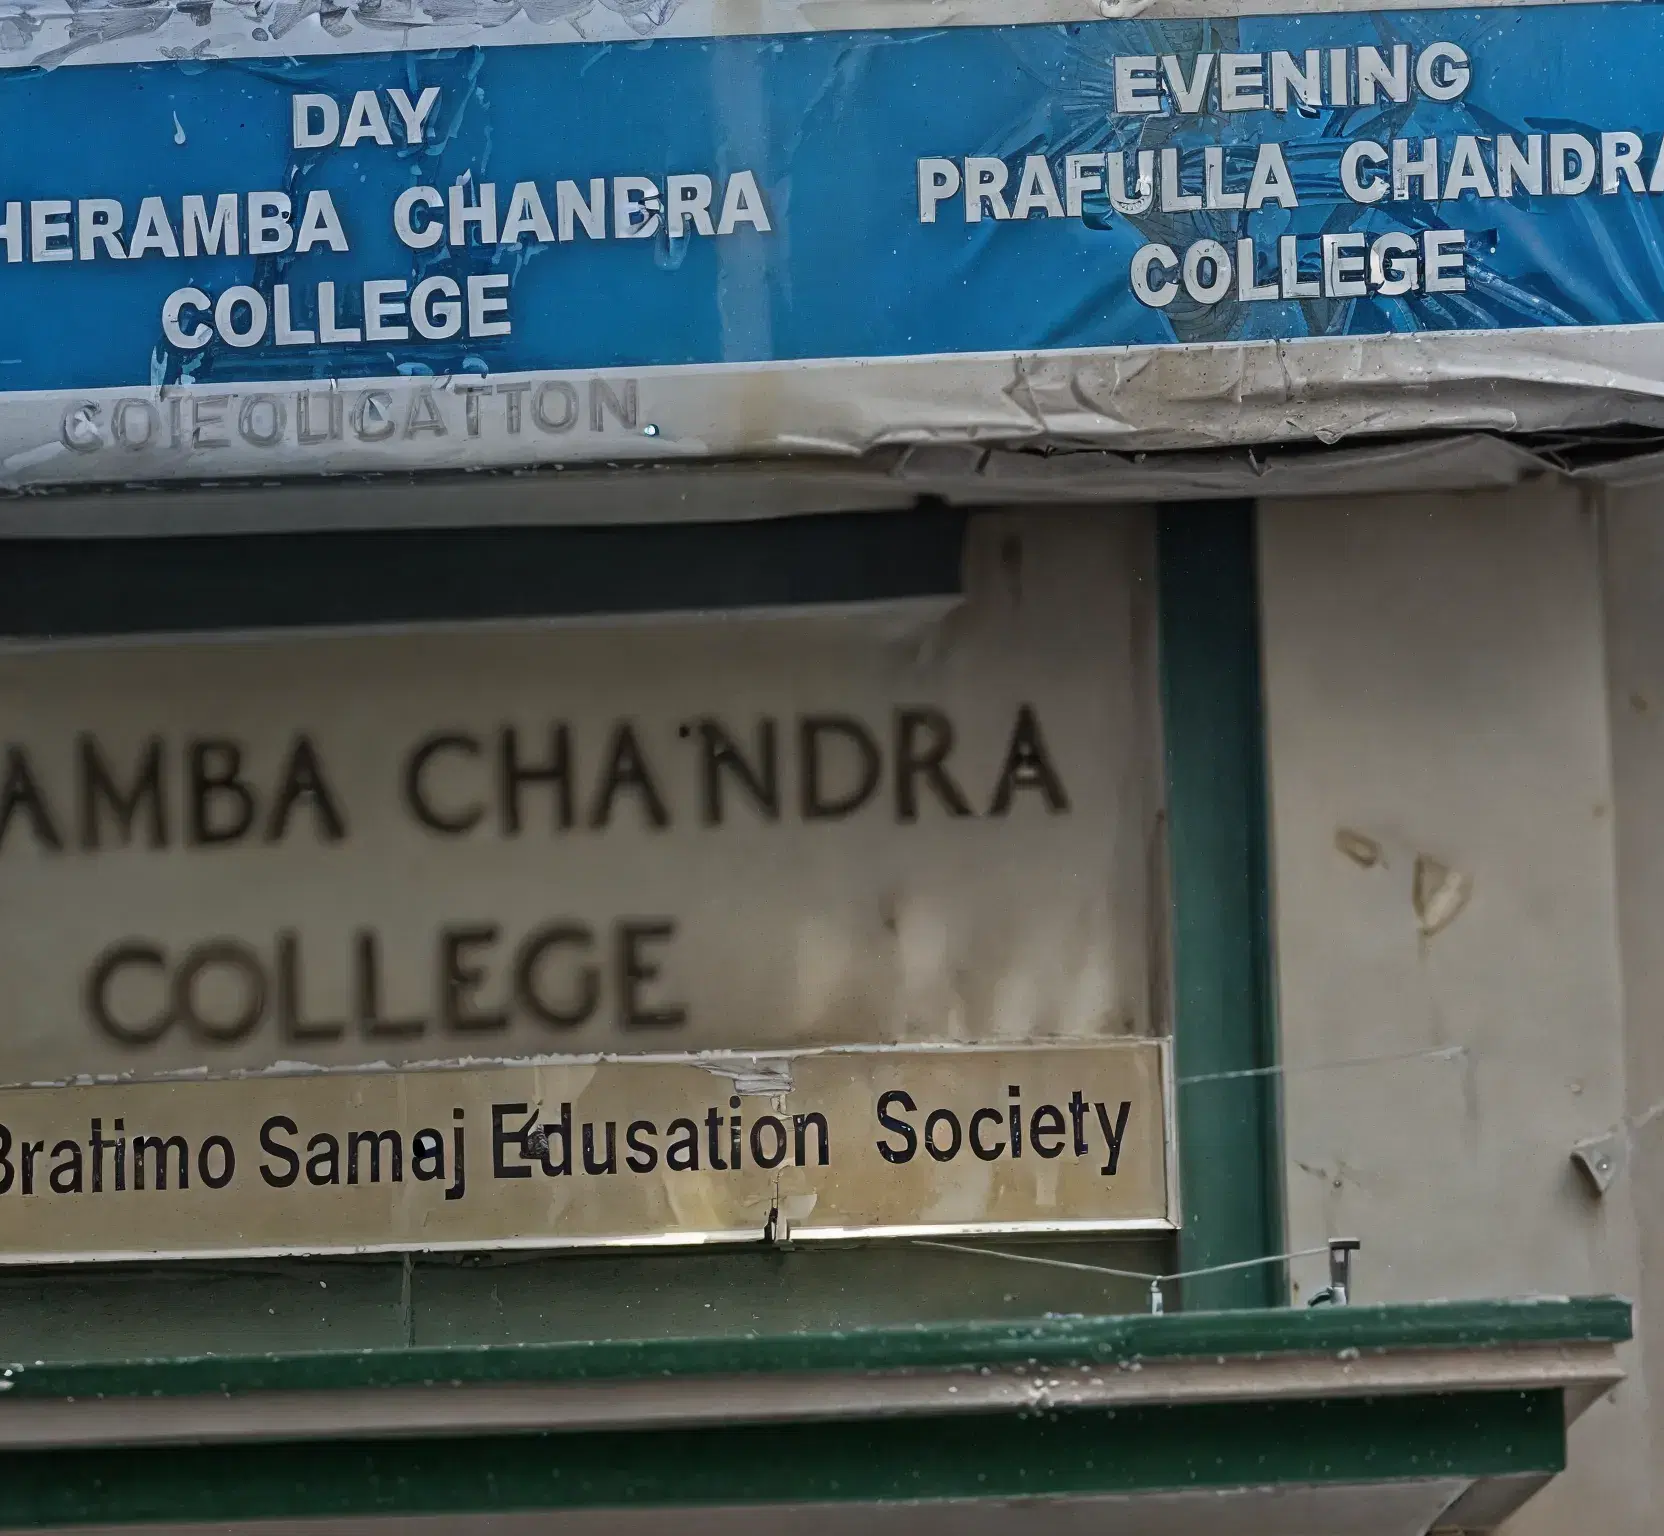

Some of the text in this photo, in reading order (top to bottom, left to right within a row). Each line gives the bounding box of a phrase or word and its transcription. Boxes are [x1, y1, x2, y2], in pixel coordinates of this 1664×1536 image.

[292, 86, 438, 150] DAY
[1113, 40, 1470, 115] EVENING
[917, 142, 1299, 225] PRAFULLA
[1130, 229, 1467, 309] COLLEGE
[161, 271, 512, 352] COLLEGE
[406, 704, 1072, 836] CHANDRA
[90, 920, 686, 1048] COLLEGE
[875, 1085, 1131, 1176] Society
